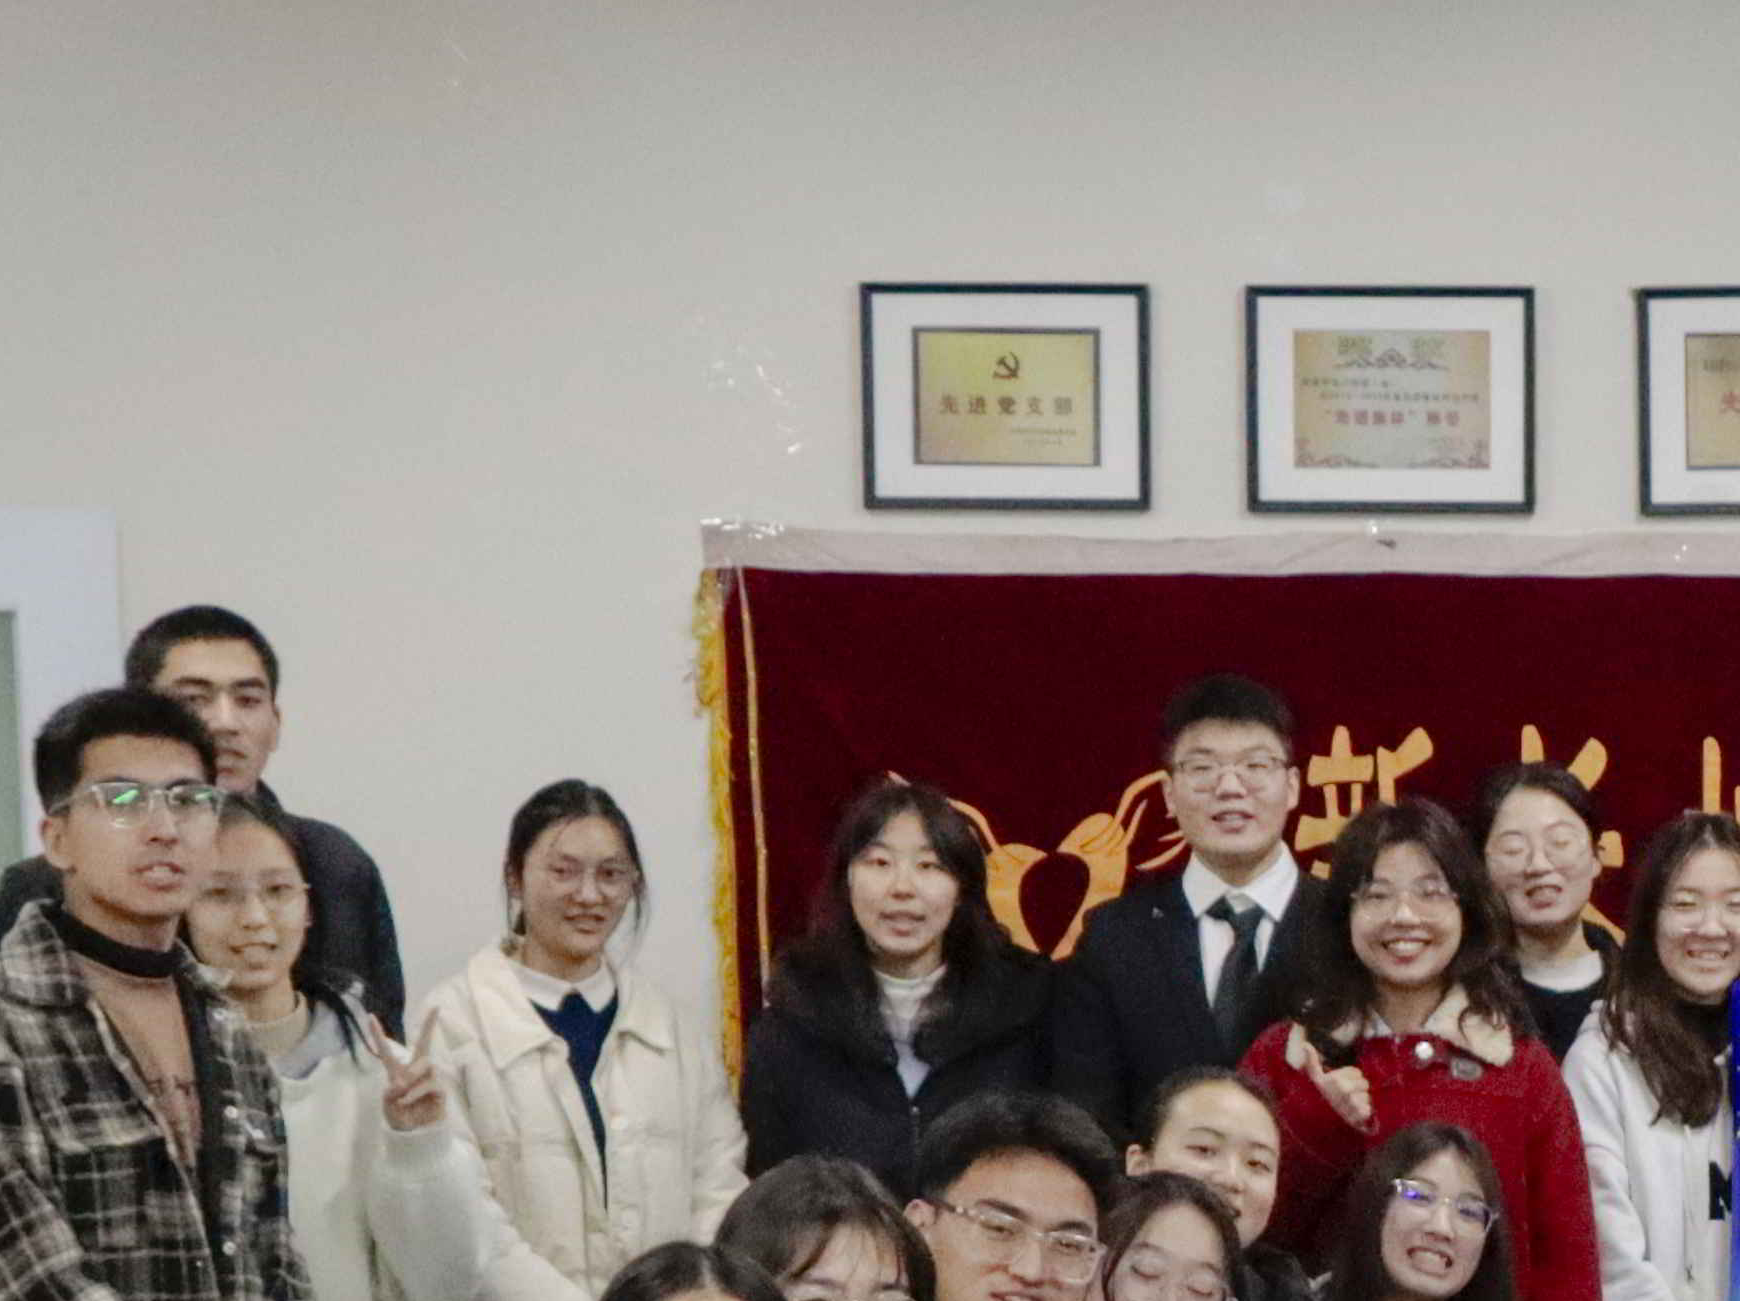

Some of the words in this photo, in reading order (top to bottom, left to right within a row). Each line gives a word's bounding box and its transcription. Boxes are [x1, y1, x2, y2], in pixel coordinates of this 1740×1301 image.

[938, 394, 1074, 416] 先进党支部
